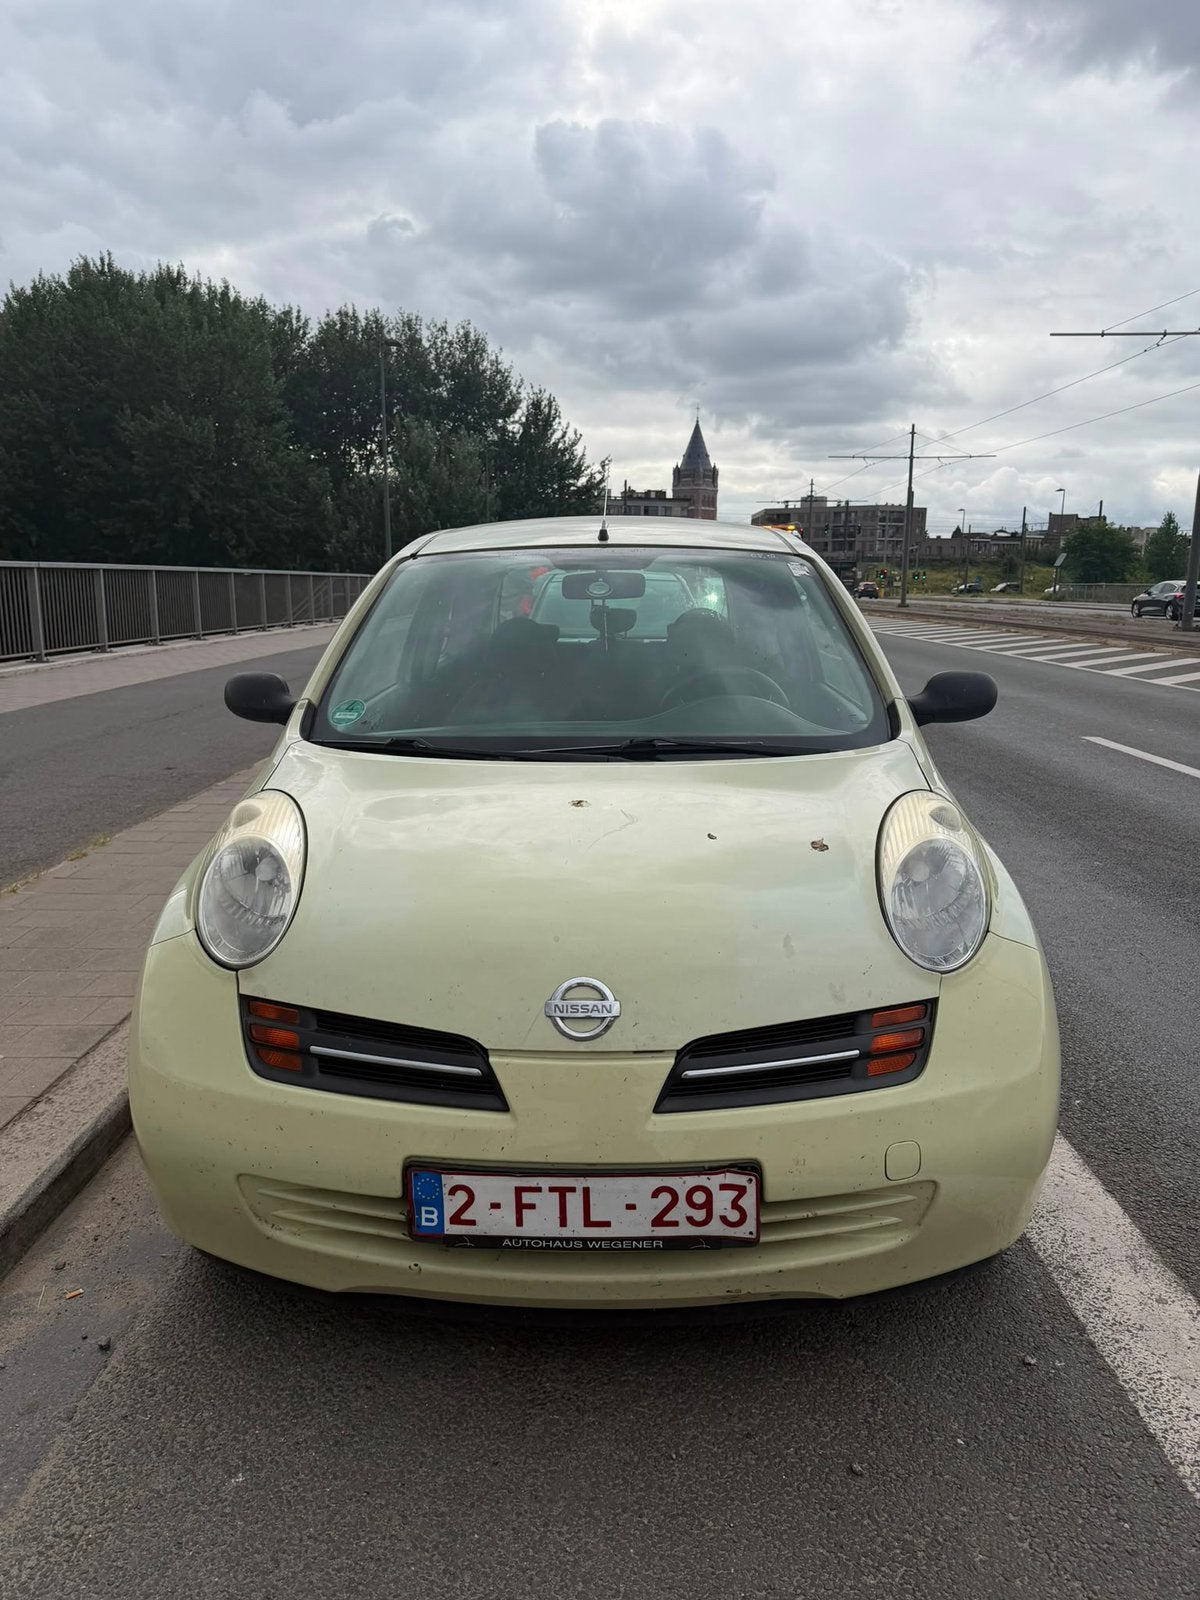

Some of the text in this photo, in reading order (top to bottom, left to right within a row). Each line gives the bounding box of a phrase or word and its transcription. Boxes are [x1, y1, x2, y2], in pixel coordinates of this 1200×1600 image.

[553, 1004, 612, 1014] NISSAN
[421, 1183, 748, 1228] B 2-FTL-293
[502, 1238, 663, 1249] AUTOHAUS WEGENER
